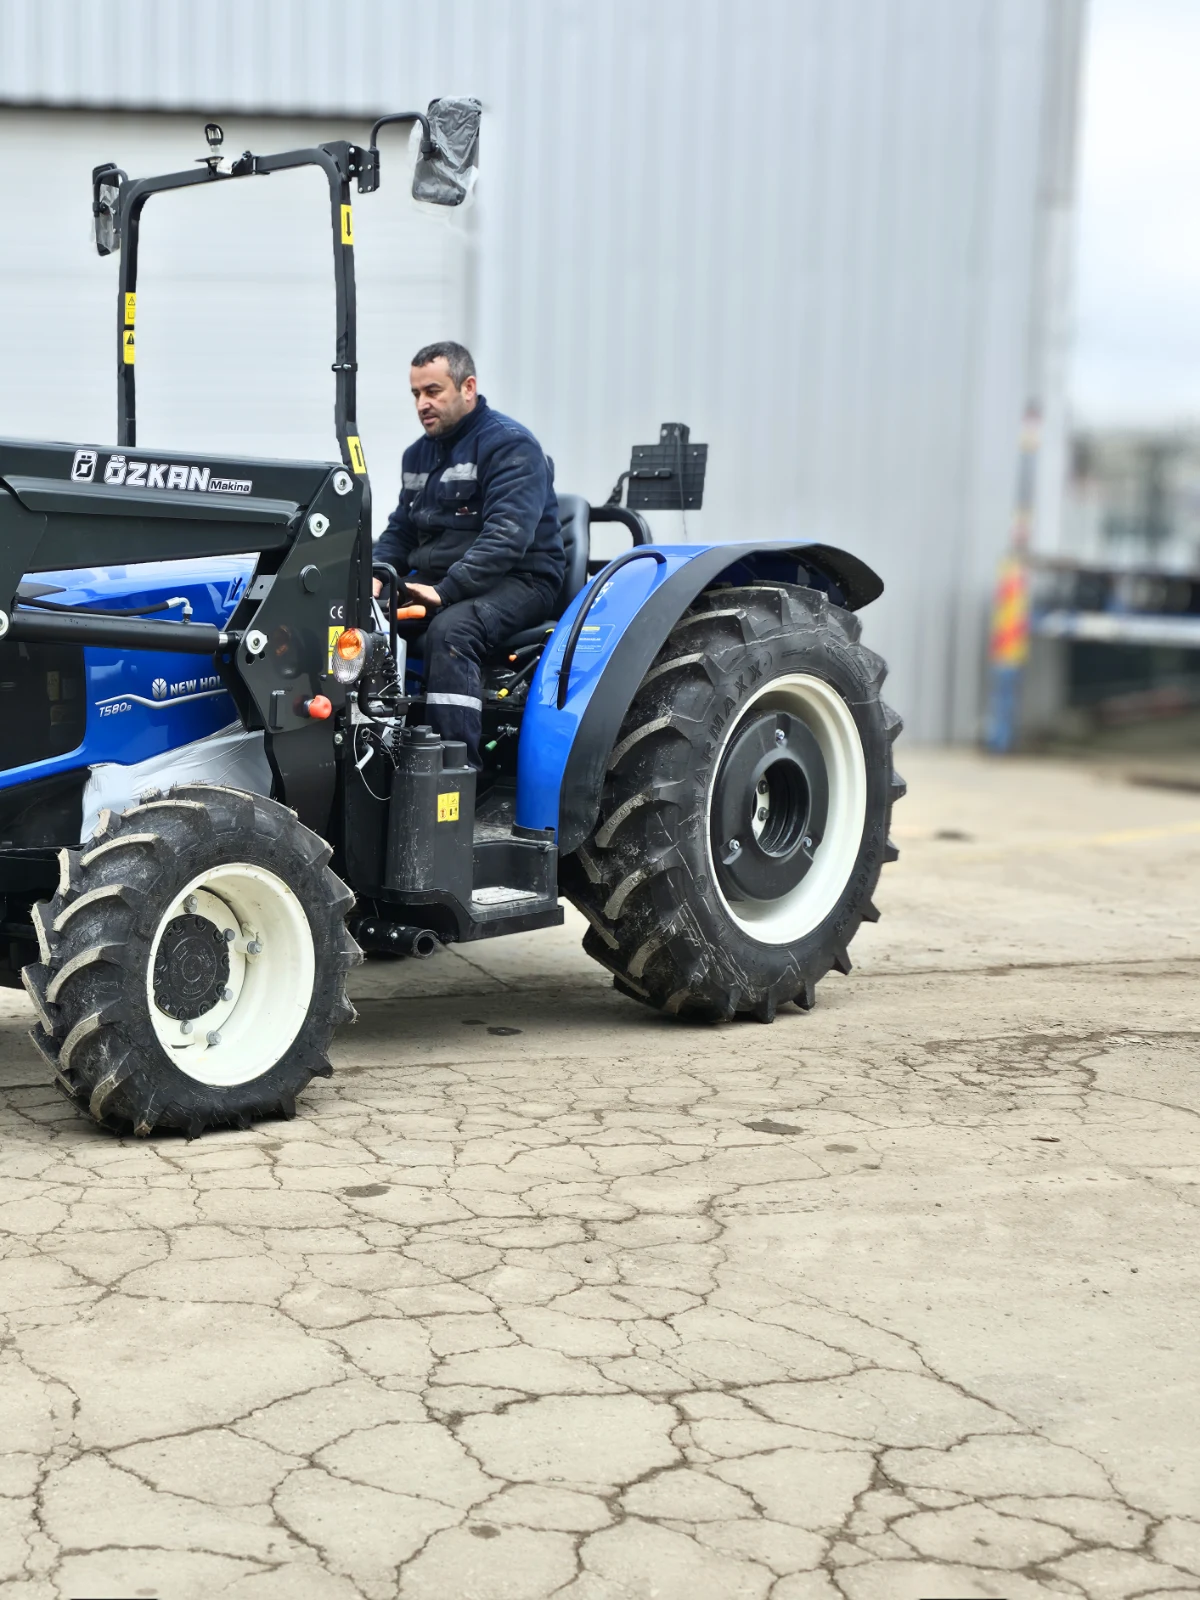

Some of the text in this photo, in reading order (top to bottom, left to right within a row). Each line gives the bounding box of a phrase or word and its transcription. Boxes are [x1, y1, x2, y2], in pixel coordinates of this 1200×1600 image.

[104, 455, 211, 491] ÖZKAN
[210, 480, 250, 493] Makina
[170, 679, 197, 696] NEW
